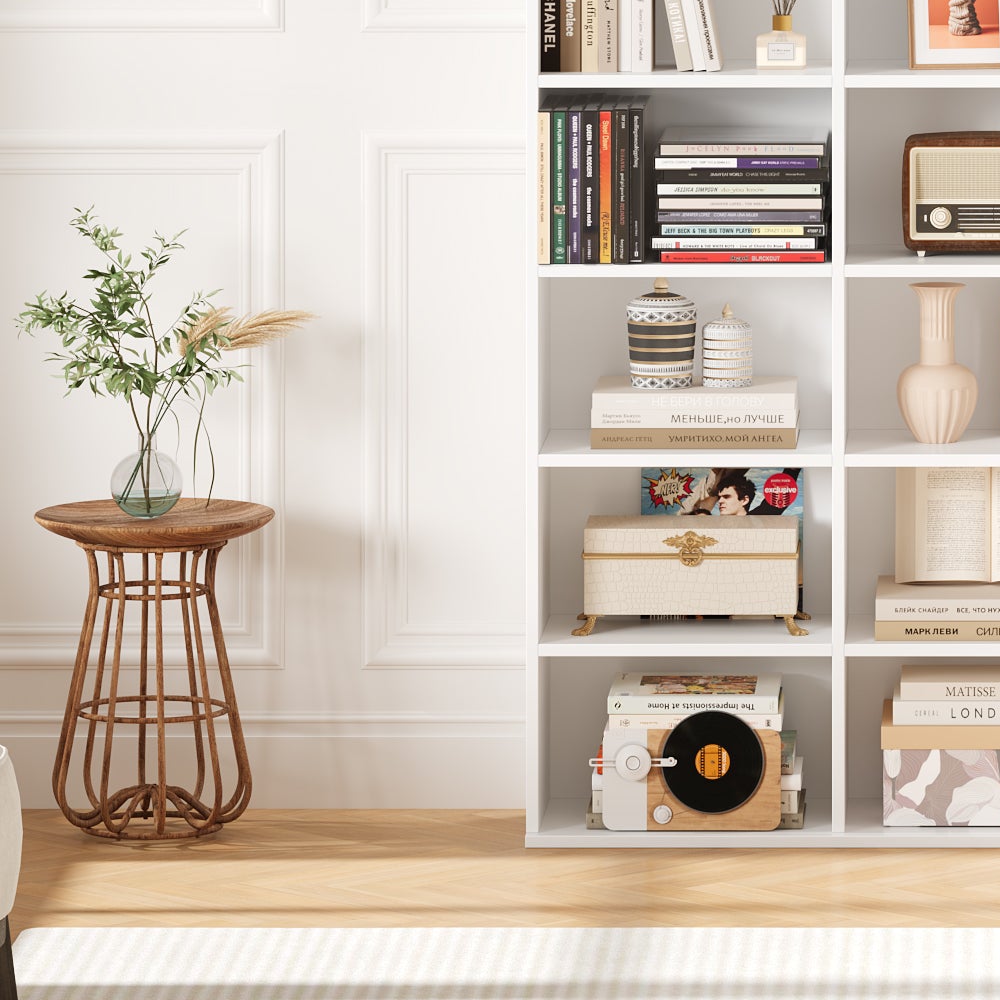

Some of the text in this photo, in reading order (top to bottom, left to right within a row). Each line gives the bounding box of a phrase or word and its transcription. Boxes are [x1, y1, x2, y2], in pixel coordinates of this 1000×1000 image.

[565, 0, 577, 38] lovelace
[668, 3, 686, 43] КОТИКА!
[703, 30, 715, 60] проектами
[602, 120, 610, 151] Steel Dawn
[742, 414, 785, 424] ЛУЧШЕ
[764, 486, 797, 494] exclusive
[894, 606, 916, 614] БЛЕЙК
[917, 606, 949, 614] СНАЙДЕР
[956, 606, 972, 615] ВСЕ,
[905, 628, 931, 636] МАРК
[932, 628, 959, 636] ЛЕВИ
[945, 686, 996, 697] MATISSE
[647, 702, 670, 710] Home
[682, 702, 739, 711] Impressionists
[741, 702, 755, 710] The
